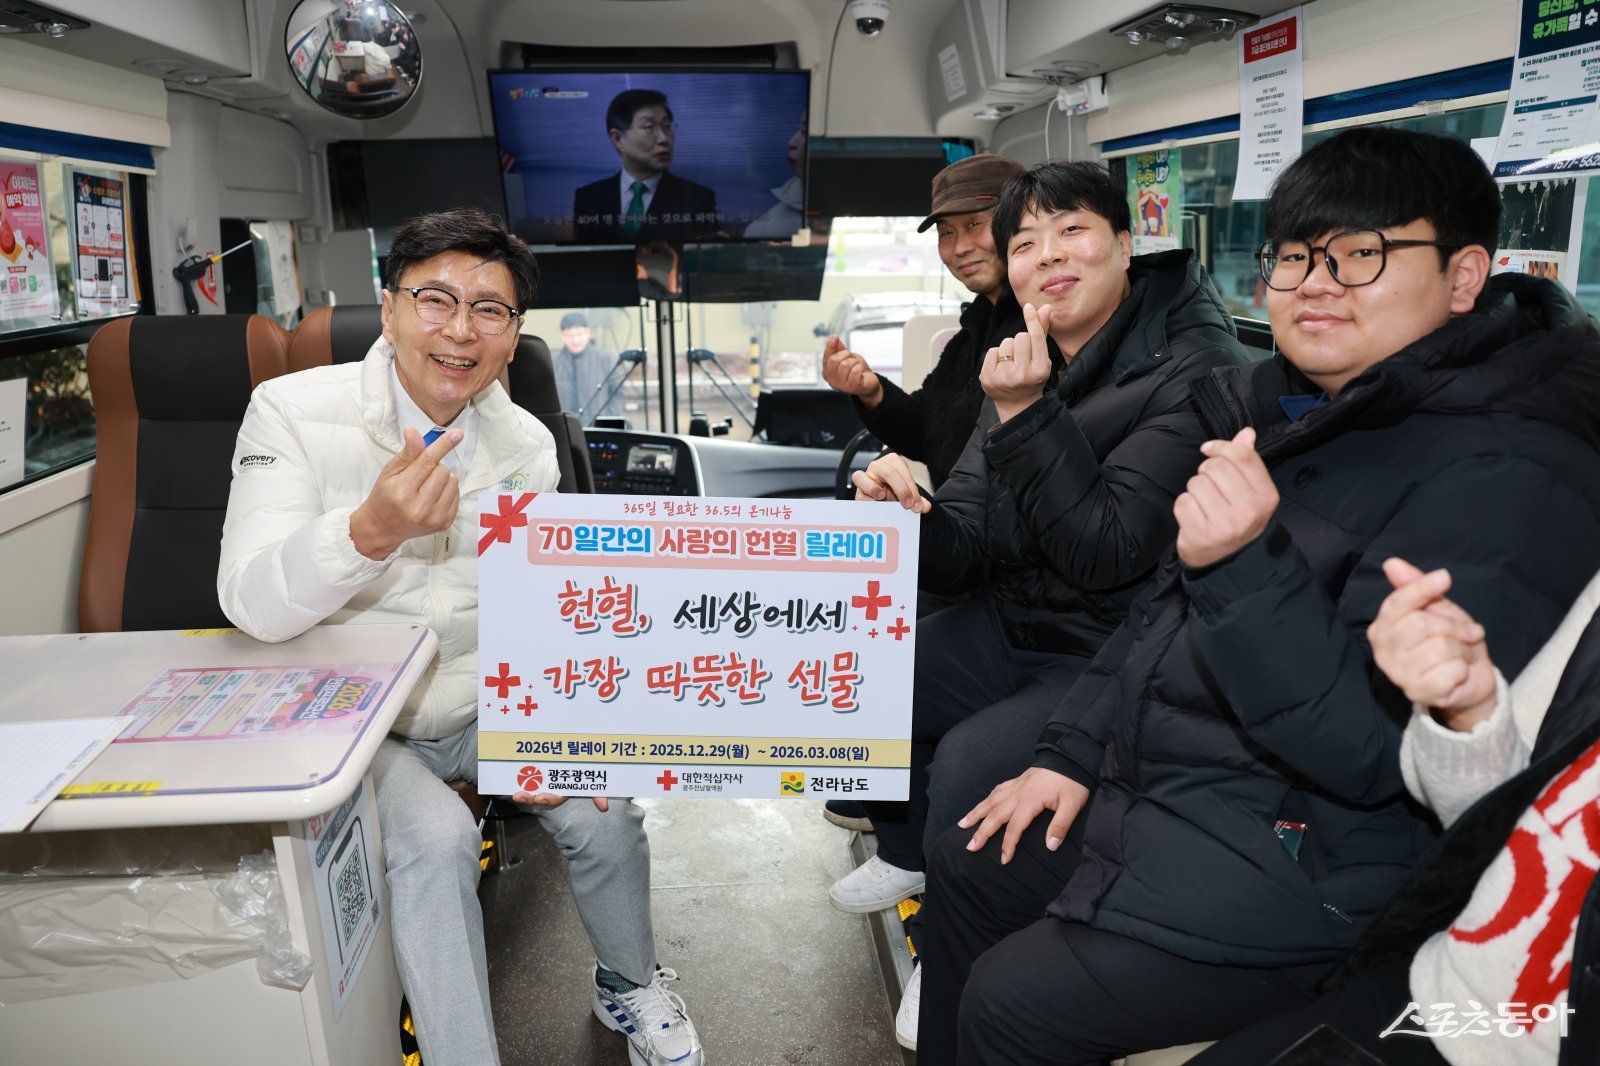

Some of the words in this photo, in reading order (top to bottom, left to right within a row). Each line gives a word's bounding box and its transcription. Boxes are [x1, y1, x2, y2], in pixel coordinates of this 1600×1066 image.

[1533, 12, 1582, 39] 유가족일
[1585, 8, 1599, 26] 수
[12, 175, 37, 190] 이제는
[6, 192, 22, 207] 예약
[623, 501, 656, 516] 365일
[663, 501, 698, 517] 필요한
[705, 504, 741, 517] 36.5의
[749, 504, 793, 519] 온기나눔
[538, 525, 651, 553] 70일간의
[659, 528, 737, 555] 사랑의
[745, 530, 798, 557] 헌혈
[806, 532, 884, 559] 릴레이
[557, 575, 650, 635] 헌혈,
[673, 590, 845, 636] 세상에서
[543, 655, 628, 701] 가장
[646, 652, 770, 706] 따뜻한
[787, 651, 862, 711] 선물
[326, 683, 369, 711] 2026
[515, 740, 564, 756] 2026년
[567, 741, 606, 756] 릴레이
[610, 742, 637, 757] 기간
[649, 743, 750, 760] 2025.12.29(월)
[769, 745, 870, 762] 2026.03.08(일)
[548, 769, 608, 783] 광주광역시
[682, 772, 744, 784] 대한적십자사
[810, 777, 870, 792] 전라남도
[590, 783, 608, 791] CITY
